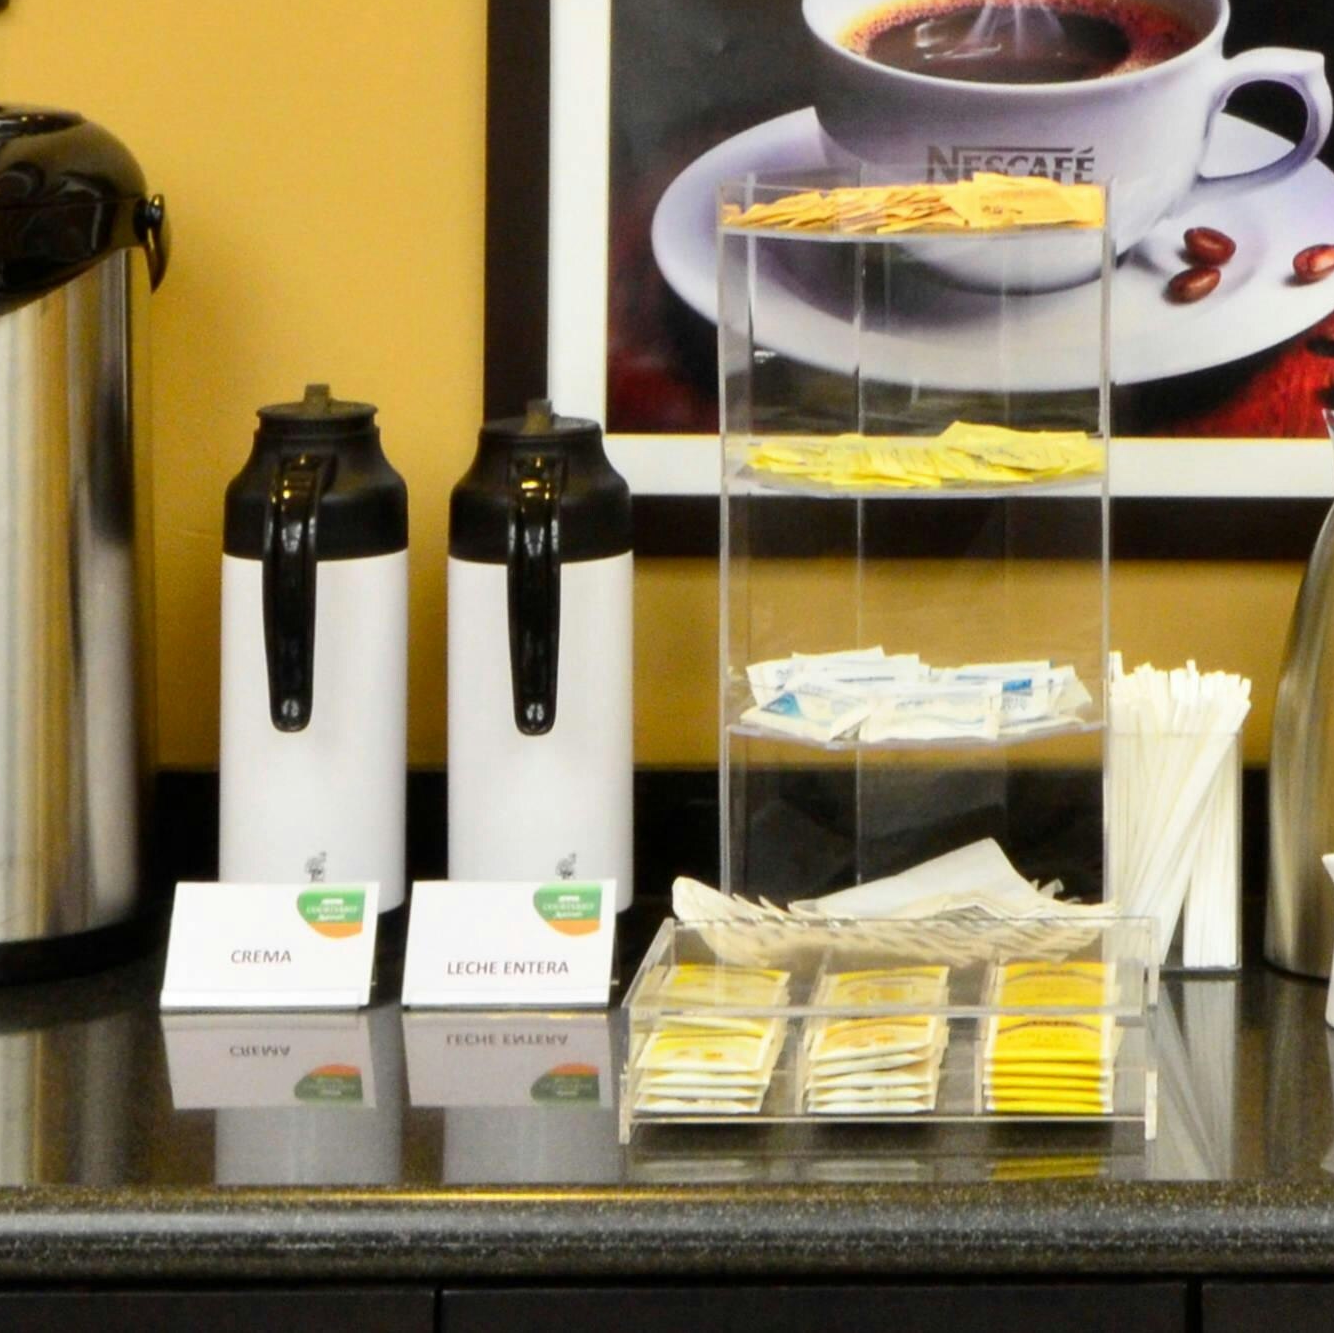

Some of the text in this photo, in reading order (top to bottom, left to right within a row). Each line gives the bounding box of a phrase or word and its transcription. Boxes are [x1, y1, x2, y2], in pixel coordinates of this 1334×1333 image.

[926, 145, 1096, 185] NESCAFÉ
[230, 949, 292, 964] CREMA
[447, 960, 569, 975] LECHE ENTERA
